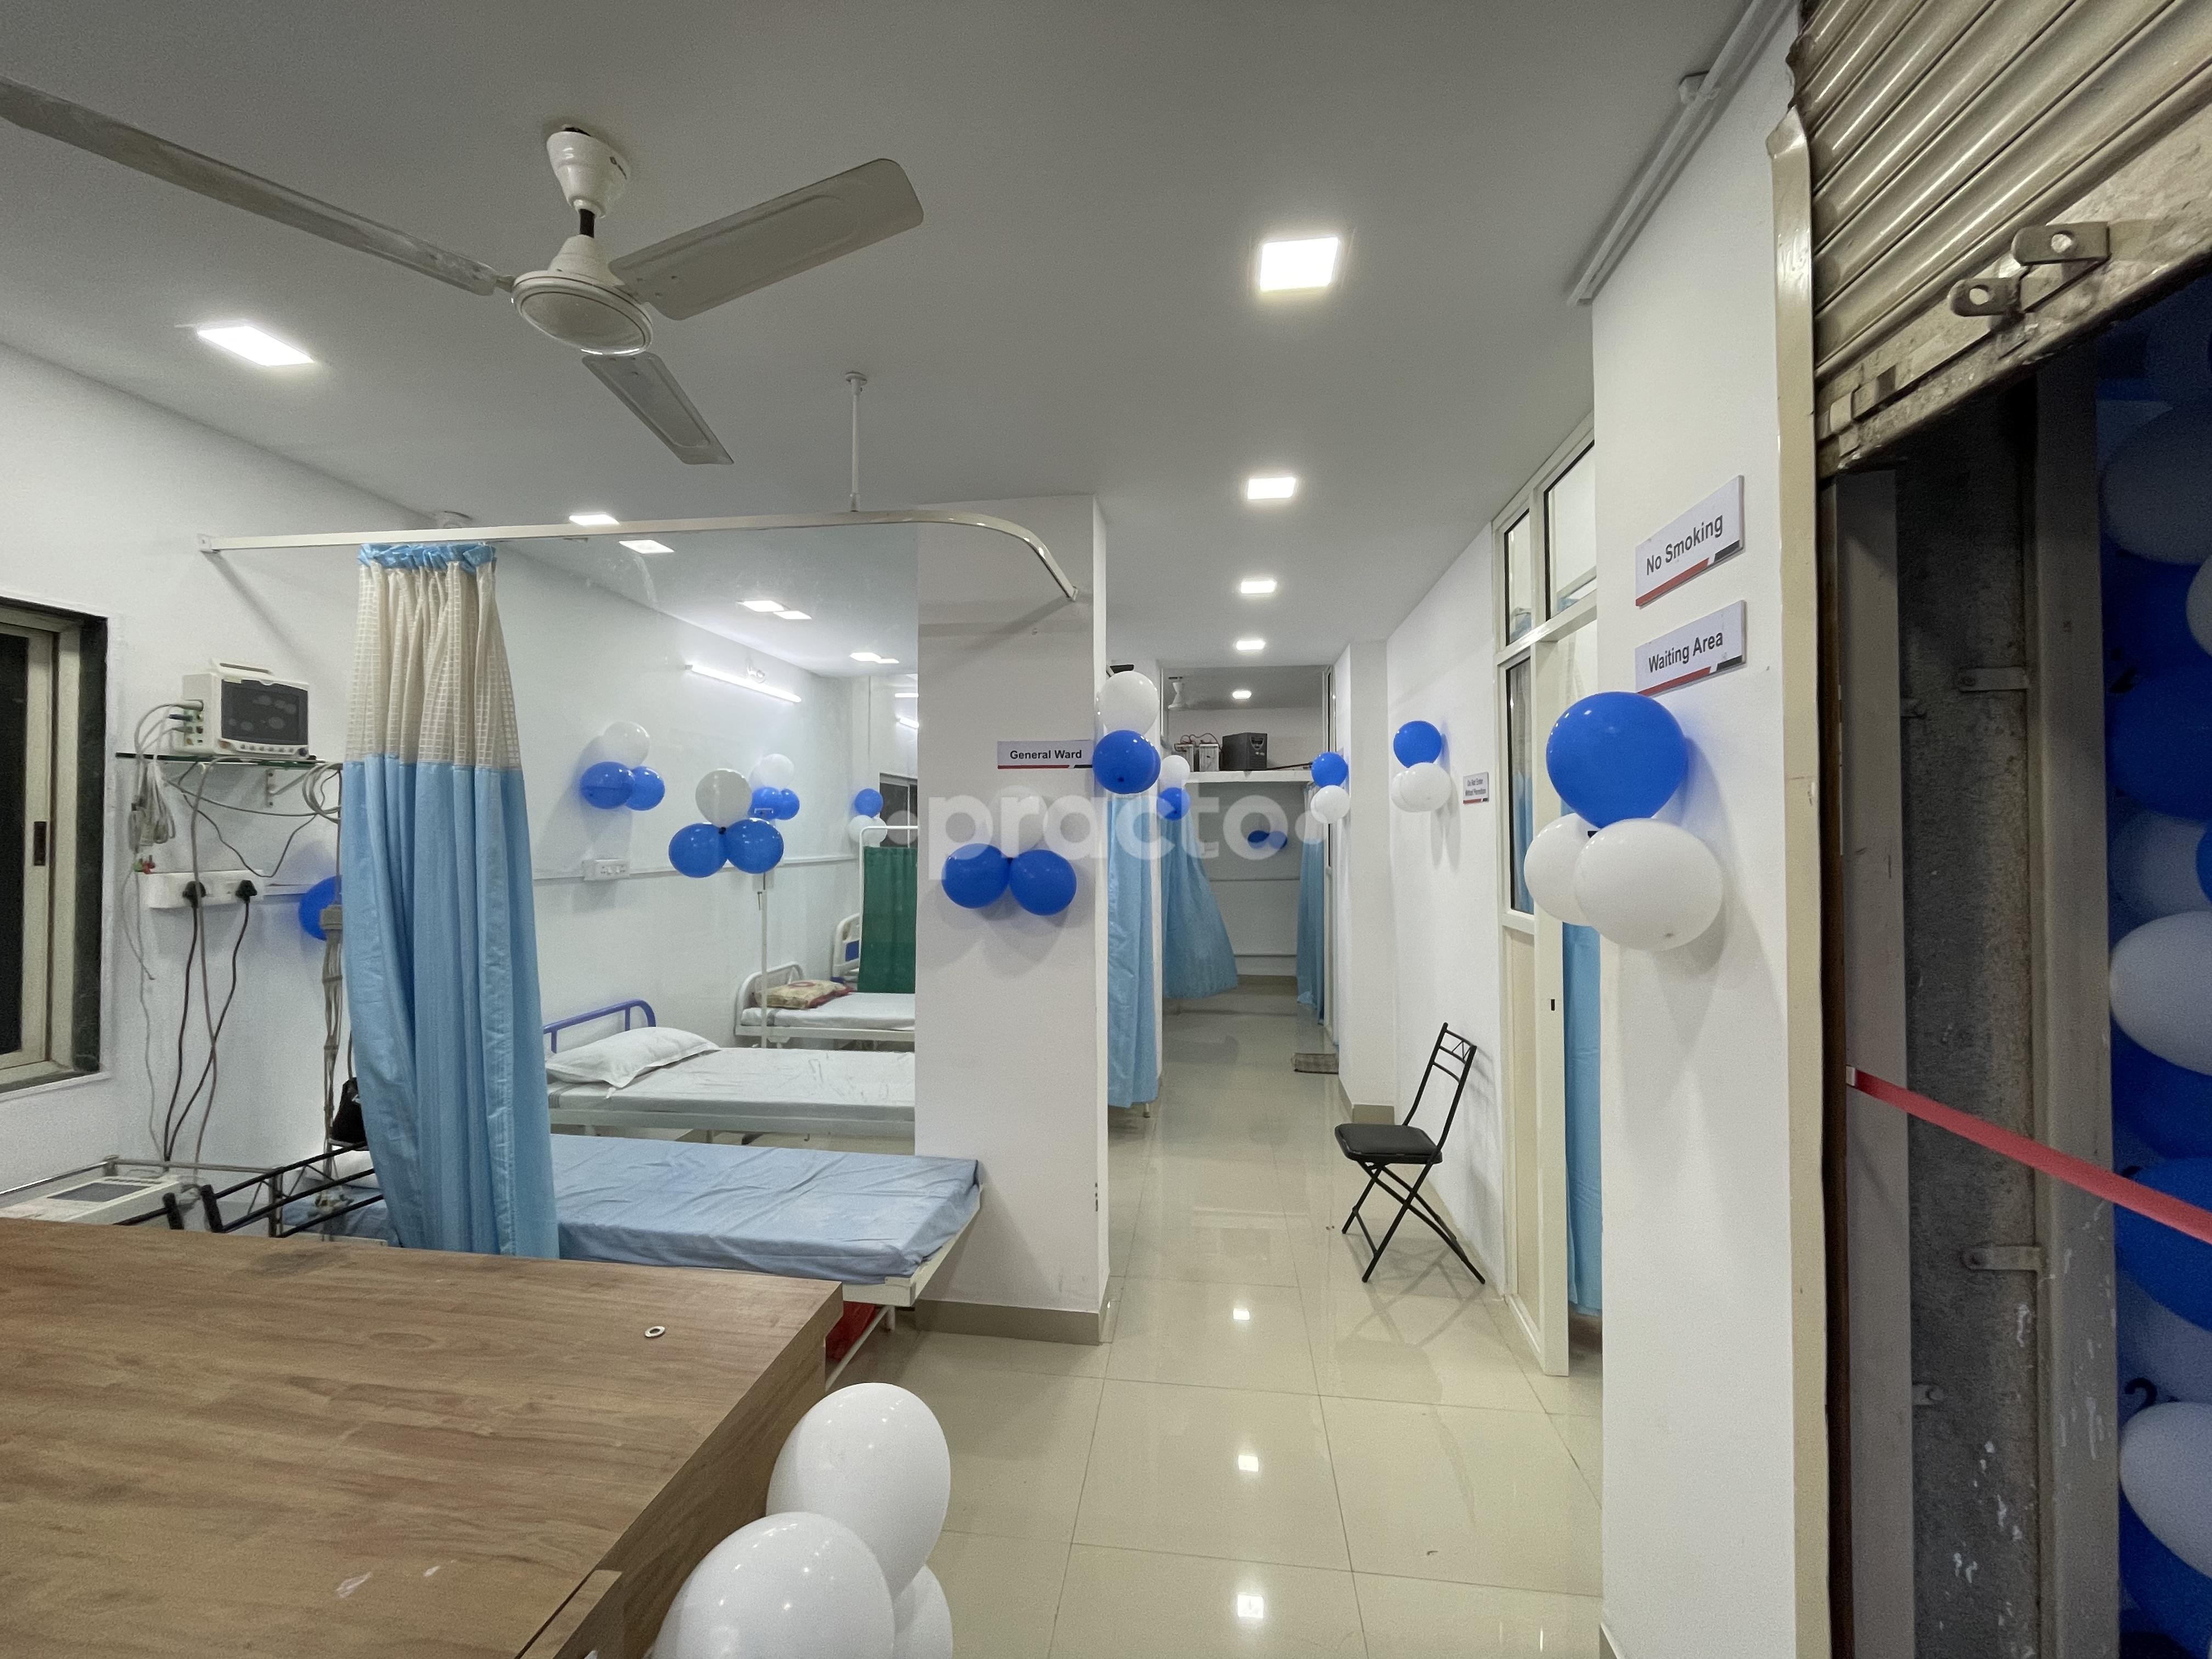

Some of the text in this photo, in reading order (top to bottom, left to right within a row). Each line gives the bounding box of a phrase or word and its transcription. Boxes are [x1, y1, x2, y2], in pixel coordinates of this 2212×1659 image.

[1646, 515, 1723, 575] No Smoking
[1649, 631, 1723, 673] Waiting Area
[1010, 749, 1082, 759] General Ward
